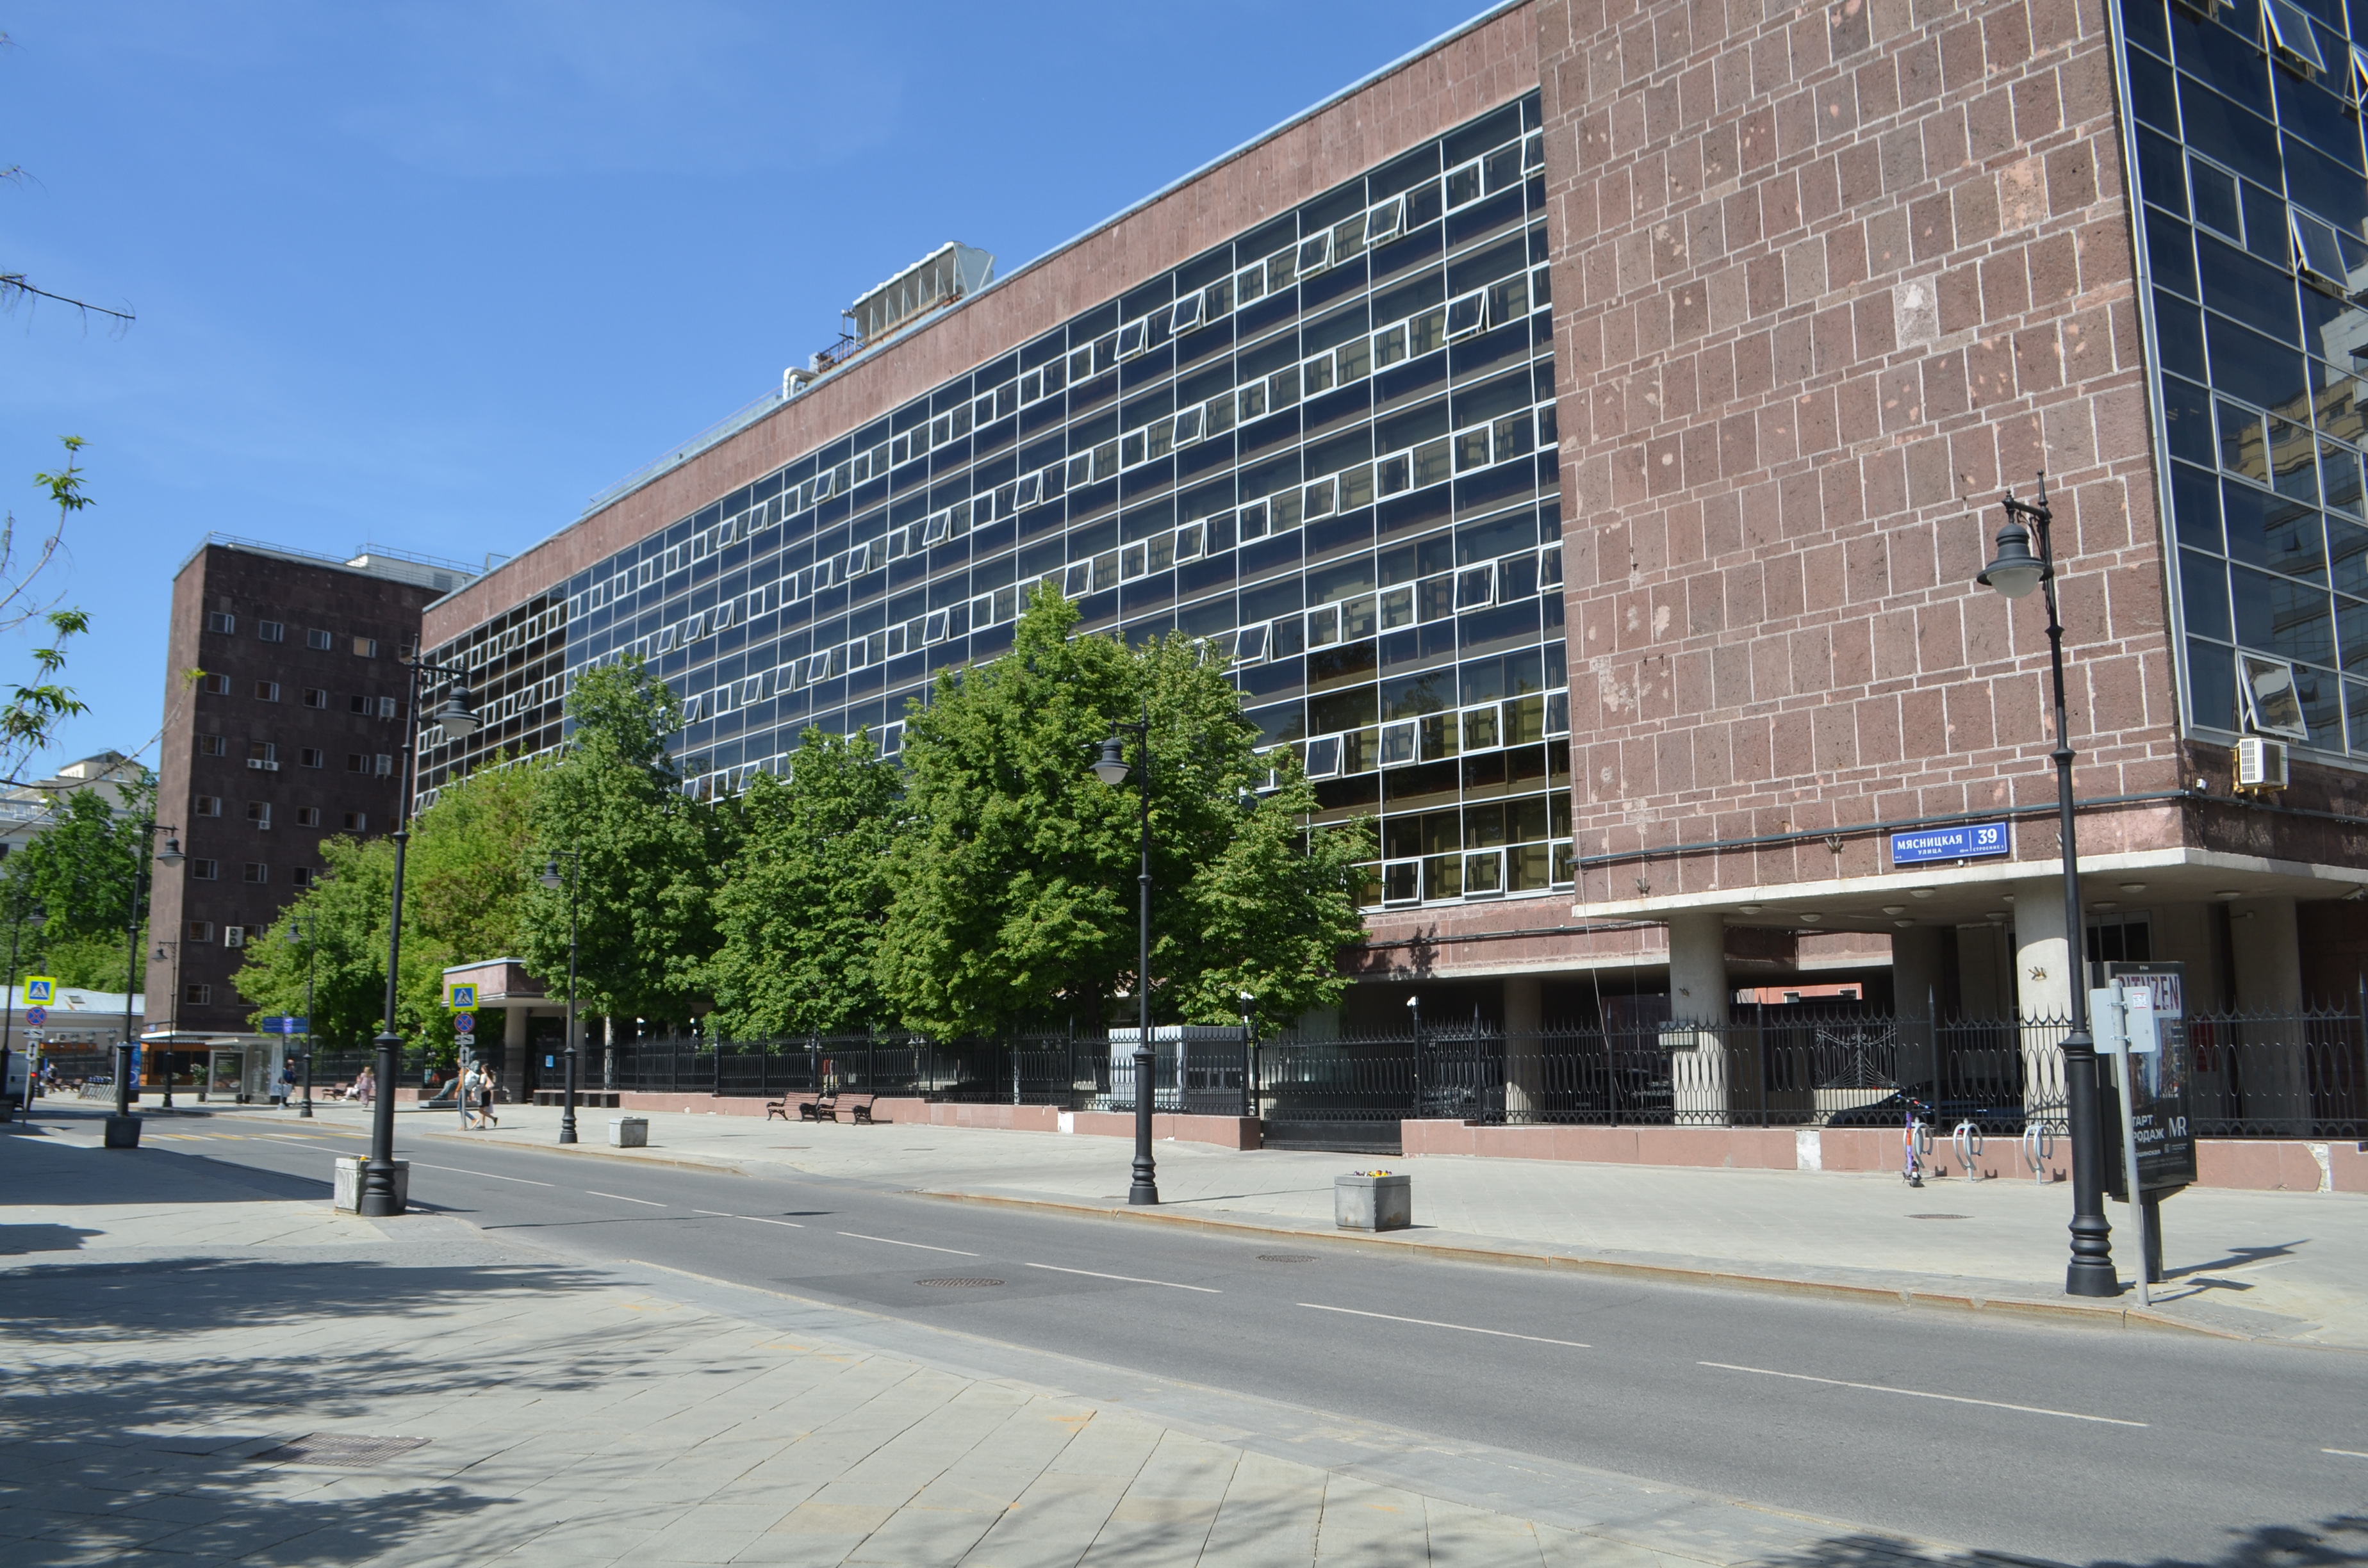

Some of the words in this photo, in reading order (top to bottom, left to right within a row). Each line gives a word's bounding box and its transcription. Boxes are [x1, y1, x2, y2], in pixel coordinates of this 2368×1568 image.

[1897, 835, 1962, 851] МЯСНИЦКАЯ
[1978, 828, 1997, 844] 39
[2132, 1115, 2153, 1127] ТАРТ
[2168, 1116, 2187, 1138] MR
[2134, 1128, 2164, 1143] РОДАЖ
